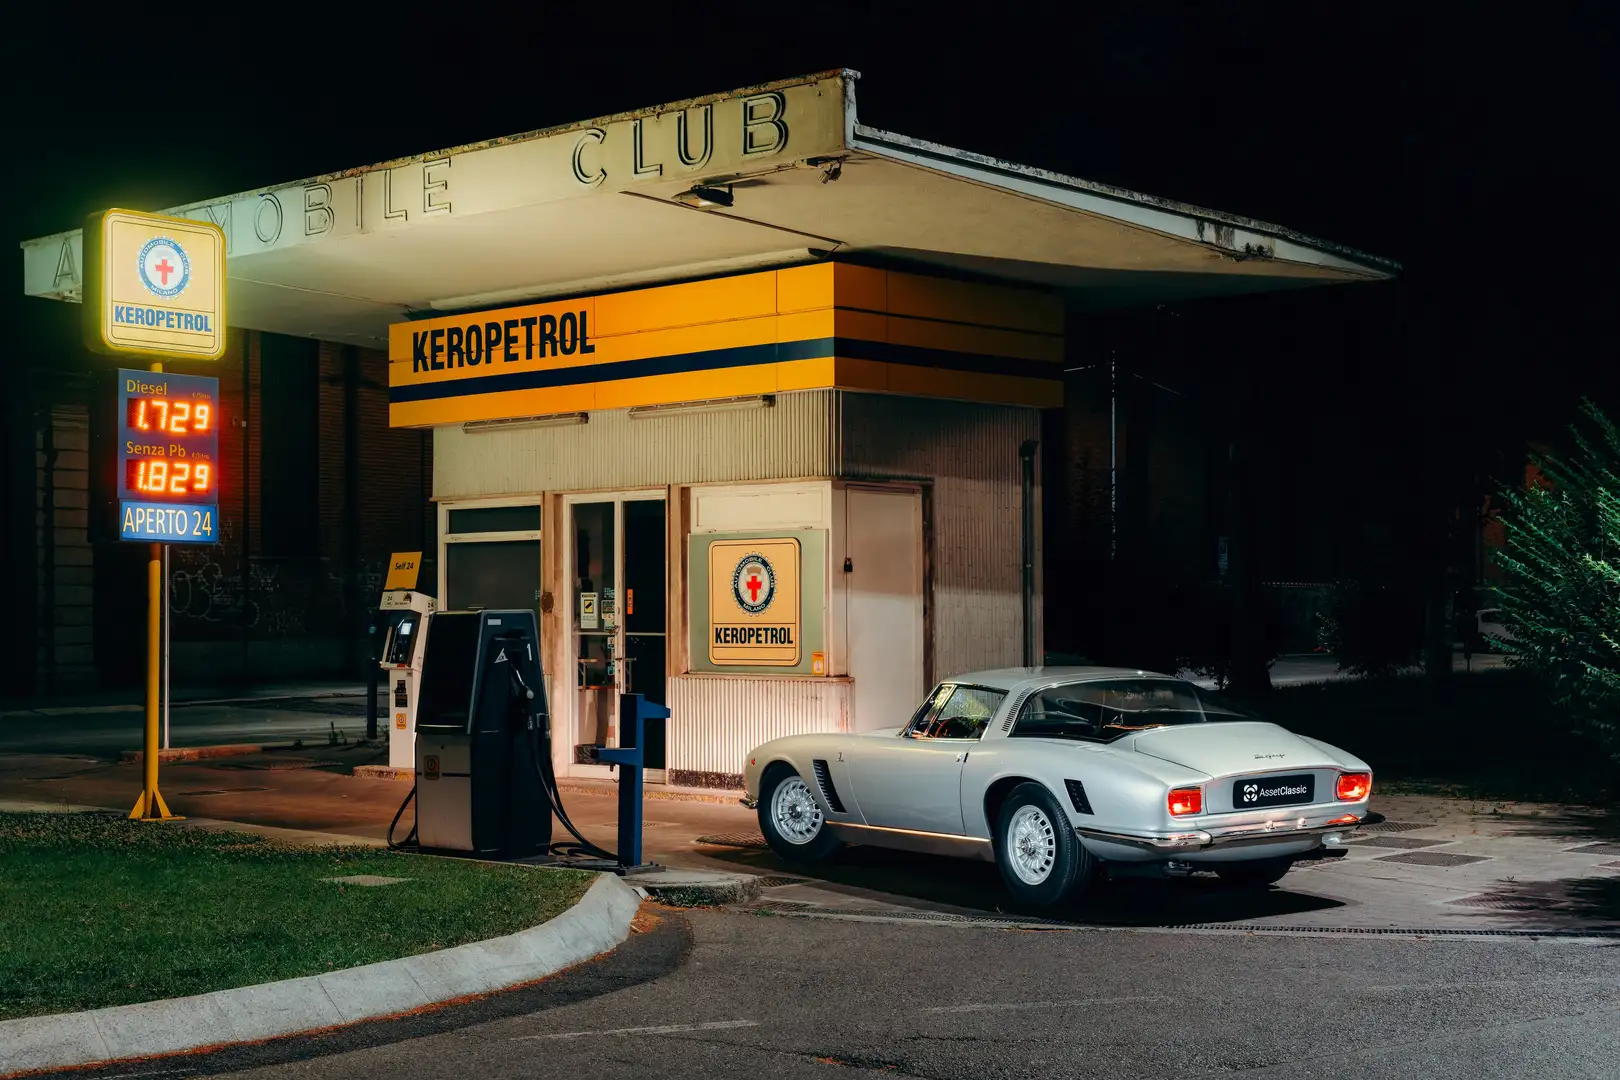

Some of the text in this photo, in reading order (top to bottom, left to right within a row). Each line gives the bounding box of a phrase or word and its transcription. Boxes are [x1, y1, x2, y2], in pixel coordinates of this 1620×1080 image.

[571, 91, 788, 188] CLUB
[114, 305, 212, 333] KEROPETROL
[412, 310, 596, 373] KEROPETROL
[126, 379, 168, 396] Diesel
[137, 400, 210, 433] 1.729
[126, 441, 165, 457] Senza
[169, 444, 186, 458] Pb
[137, 461, 210, 493] 1.829
[122, 507, 213, 537] APERTO 24
[395, 561, 414, 570] Self 24
[742, 603, 766, 612] MILANO
[715, 627, 793, 645] KEROPETROL
[526, 643, 533, 662] 1
[1259, 784, 1307, 798] AssetClassic
